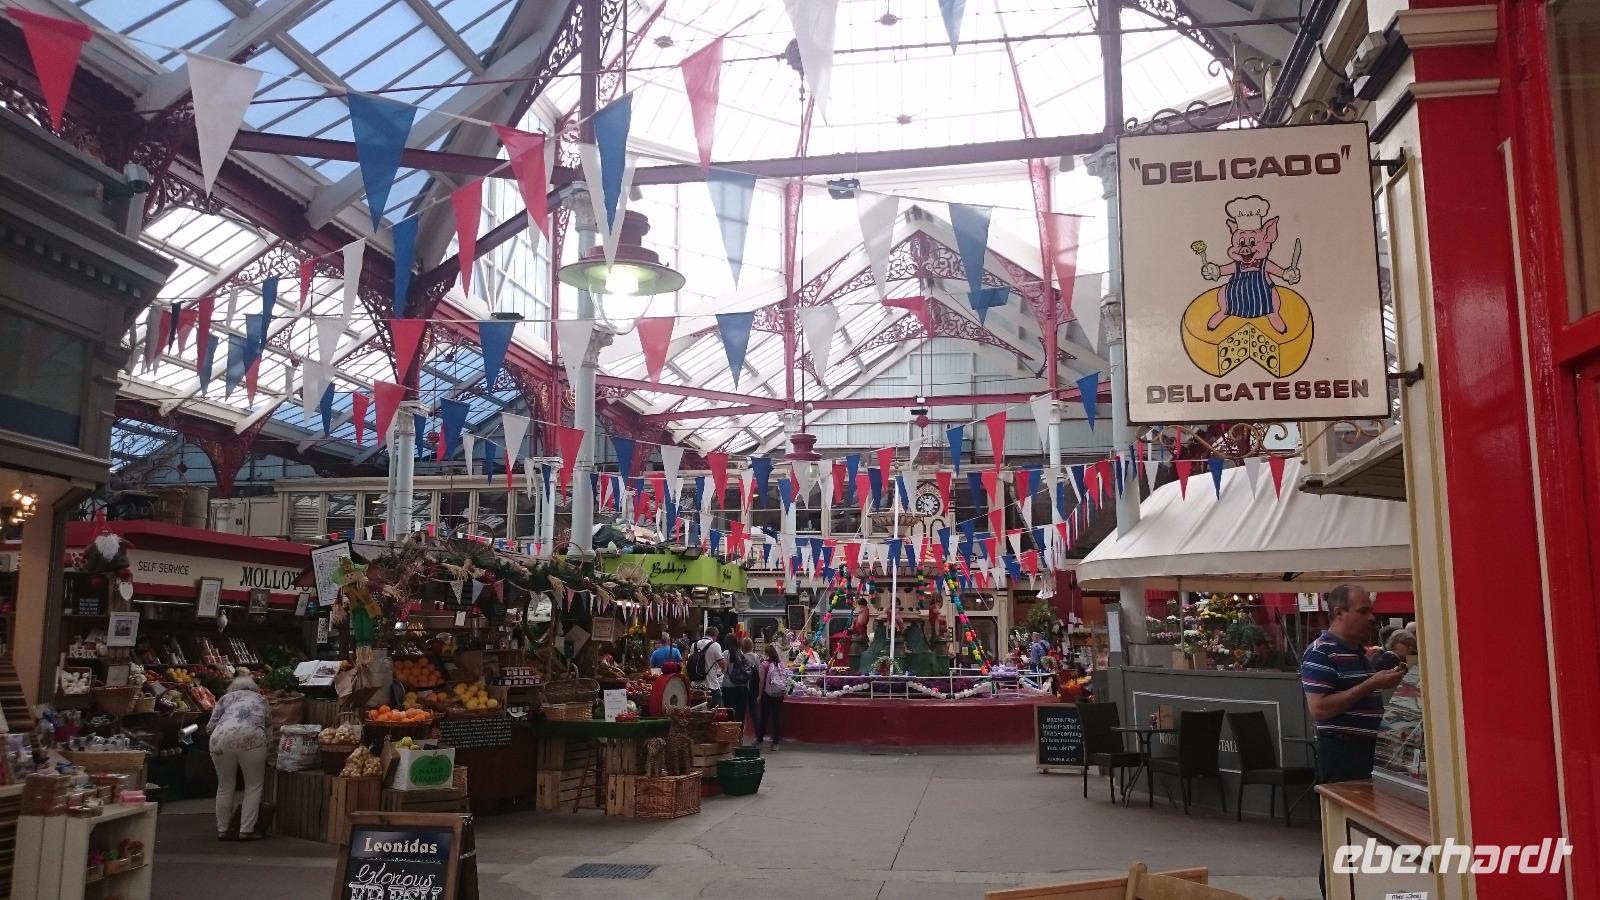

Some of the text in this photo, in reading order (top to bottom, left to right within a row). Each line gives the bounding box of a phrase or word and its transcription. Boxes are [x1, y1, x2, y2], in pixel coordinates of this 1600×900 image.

[1128, 144, 1352, 186] "DELICADO"
[1146, 378, 1370, 404] DELICATESSEN
[138, 560, 190, 575] SELF SERVICE
[240, 566, 310, 592] MOLLOY
[363, 837, 438, 854] Leonidas
[355, 862, 436, 887] Glorious
